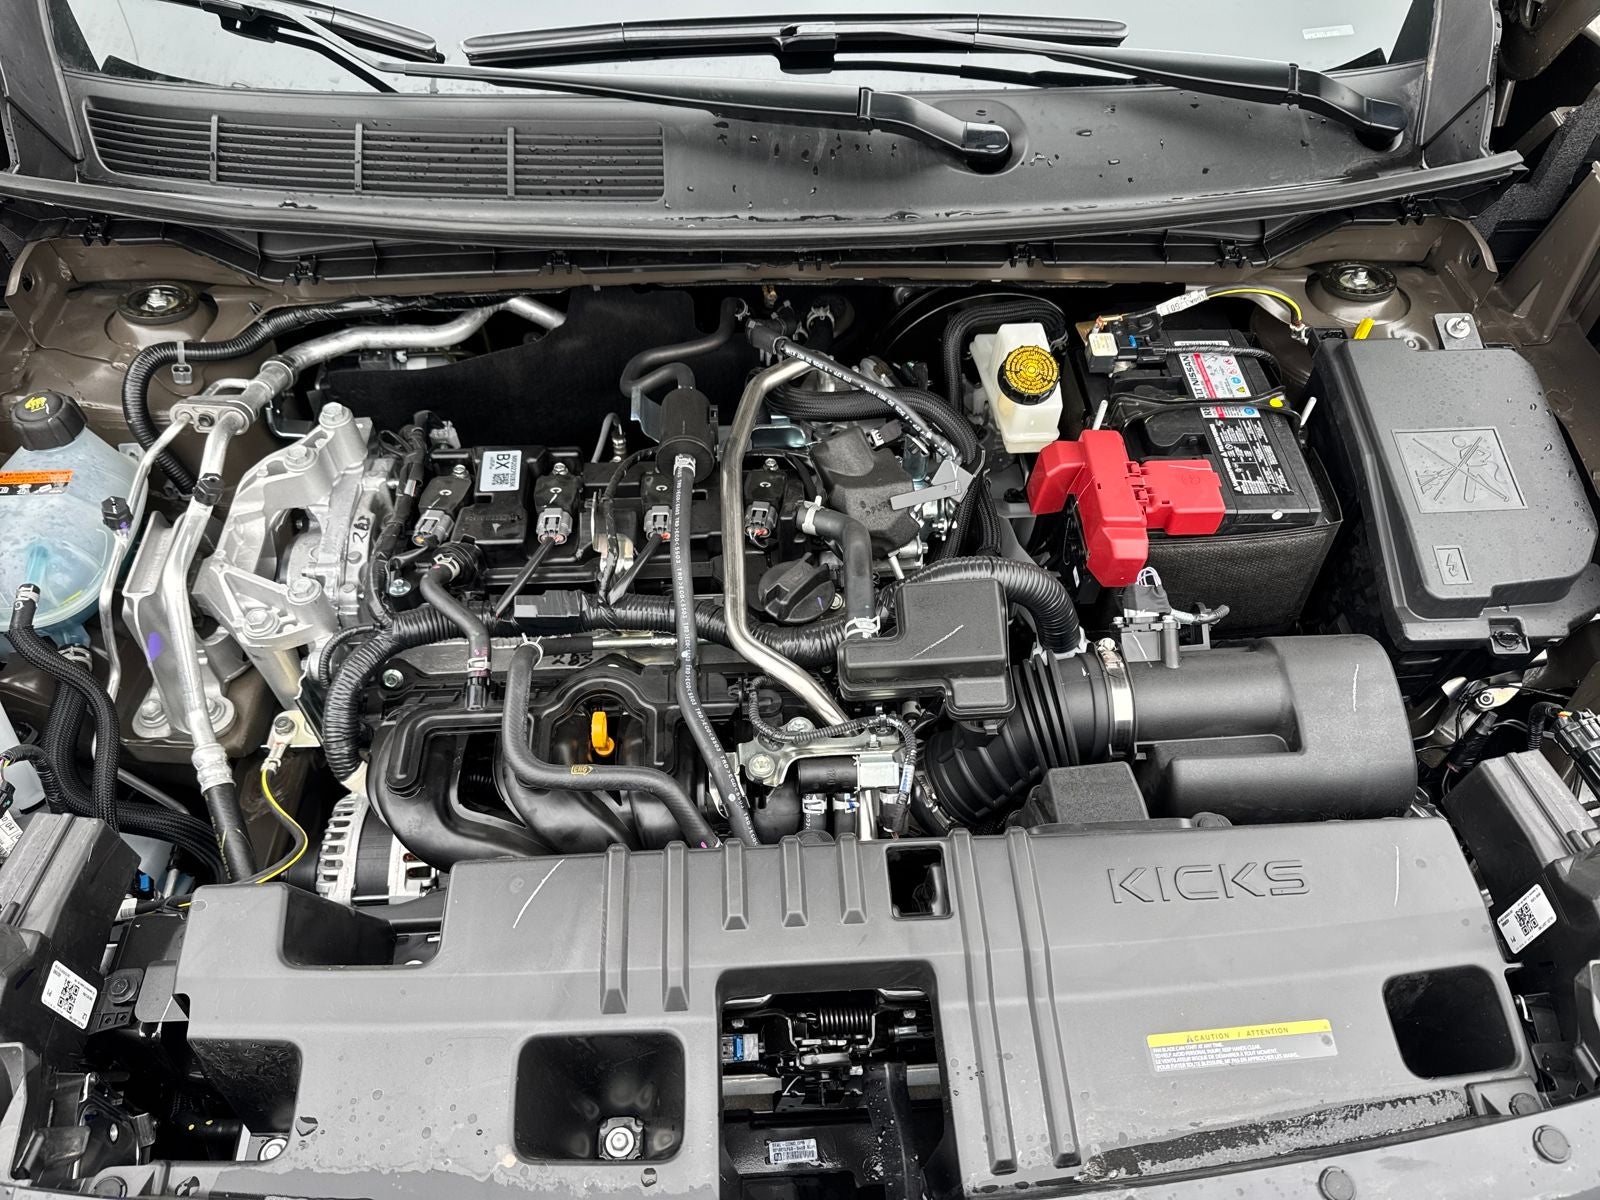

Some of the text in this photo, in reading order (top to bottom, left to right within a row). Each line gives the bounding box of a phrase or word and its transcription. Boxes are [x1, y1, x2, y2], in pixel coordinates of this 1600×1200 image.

[1181, 355, 1200, 386] NISSAN
[495, 453, 511, 470] BX
[1107, 860, 1310, 904] KICKS
[1194, 1032, 1230, 1042] CAUTION
[1246, 1026, 1289, 1037] ATTENTION
